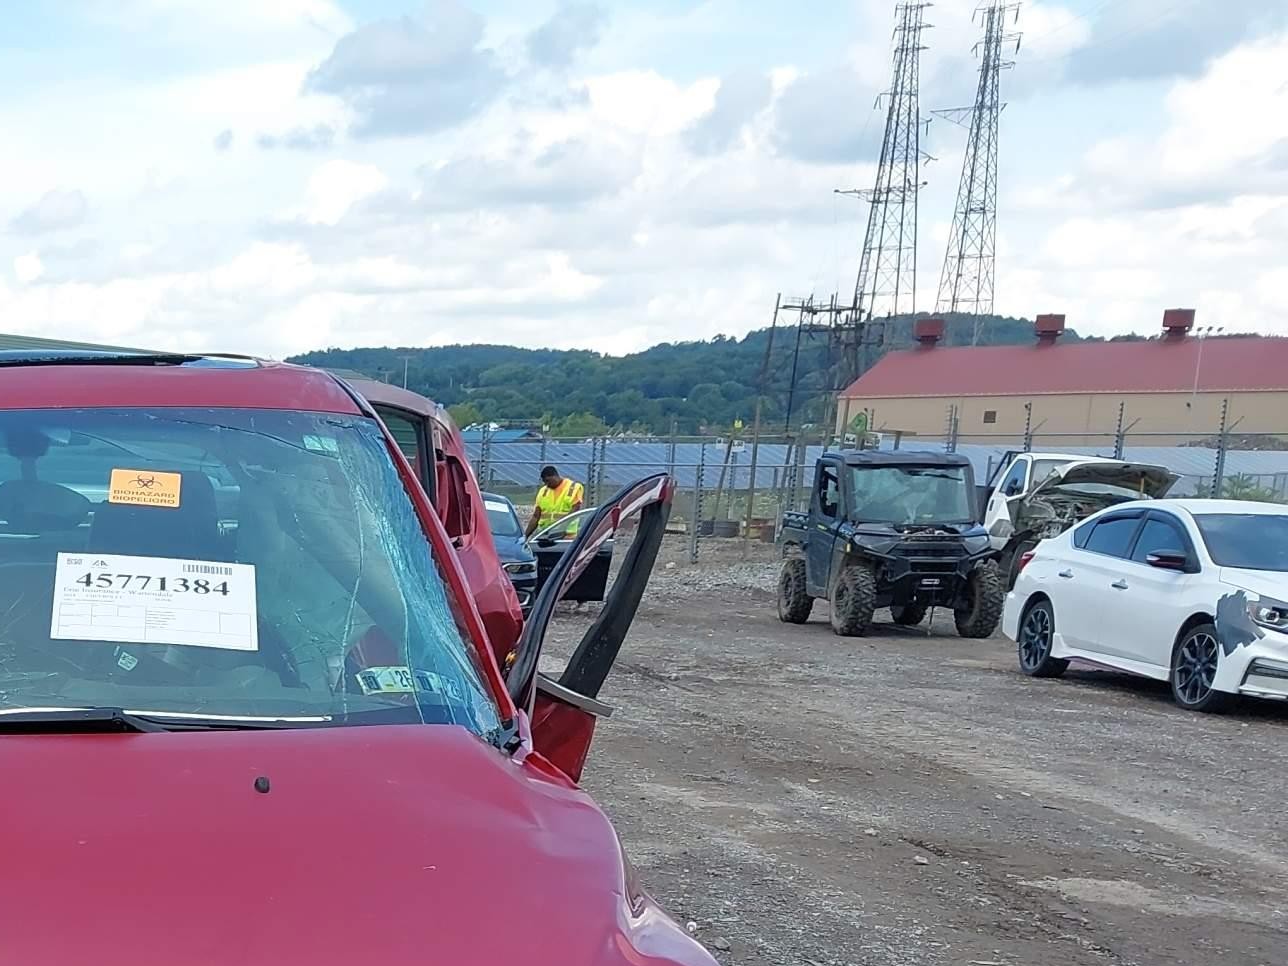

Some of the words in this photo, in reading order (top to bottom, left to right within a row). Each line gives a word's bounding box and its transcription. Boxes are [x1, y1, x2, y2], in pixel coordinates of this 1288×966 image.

[113, 489, 176, 498] BIOHAZARD
[112, 495, 176, 504] BIOPELIGRO
[75, 572, 230, 596] 45771384
